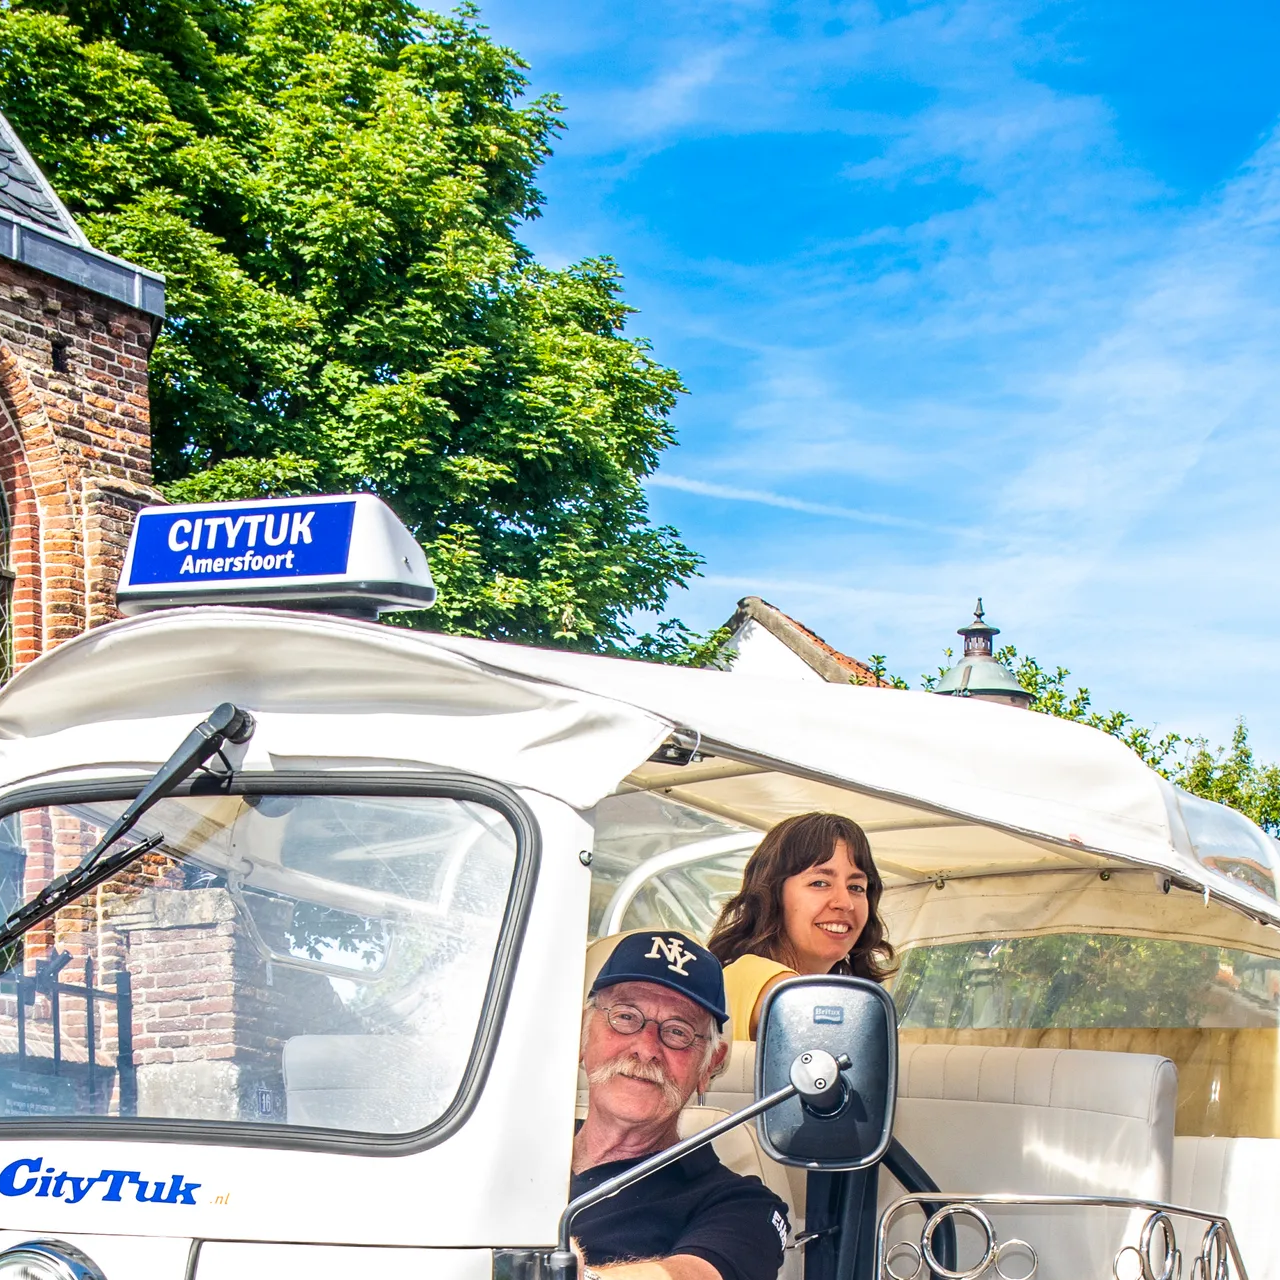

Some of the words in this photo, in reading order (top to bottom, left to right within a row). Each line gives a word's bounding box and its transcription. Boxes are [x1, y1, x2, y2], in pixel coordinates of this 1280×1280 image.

[168, 511, 316, 552] CITYTUK
[179, 550, 295, 574] Amersfoort
[645, 936, 697, 976] NY
